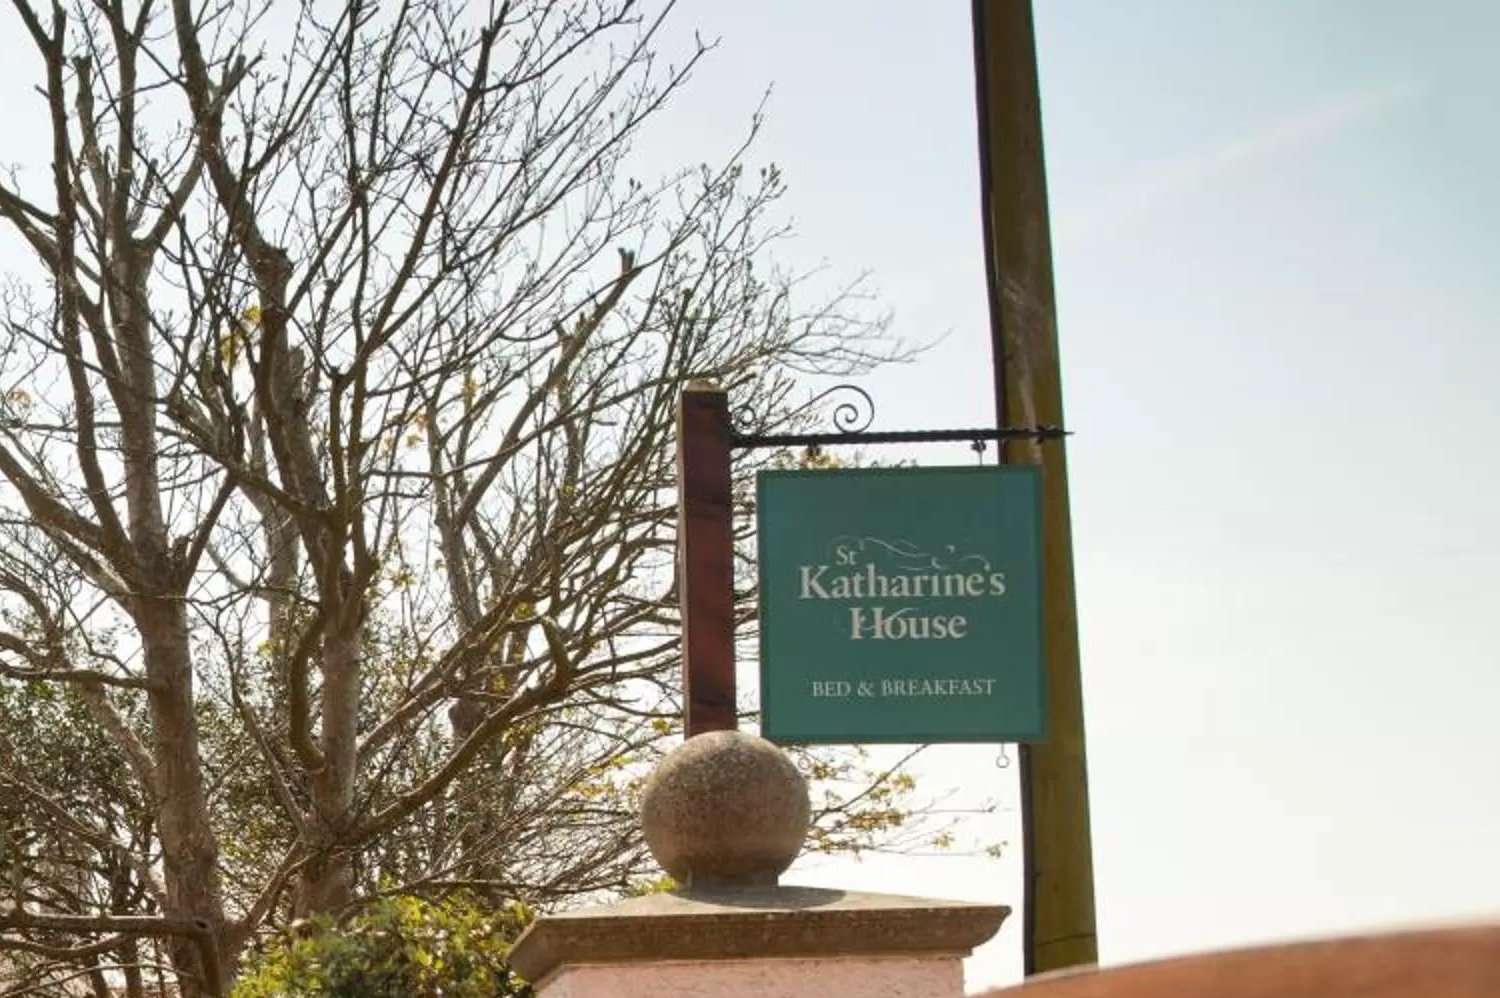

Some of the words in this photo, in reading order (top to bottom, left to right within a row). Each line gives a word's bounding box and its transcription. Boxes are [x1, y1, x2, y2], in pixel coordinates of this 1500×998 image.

[836, 545, 857, 566] St
[799, 563, 1007, 600] Katharine's
[850, 606, 968, 640] House
[812, 680, 850, 697] BED
[857, 680, 876, 697] &
[882, 678, 997, 697] BREAKFAST
